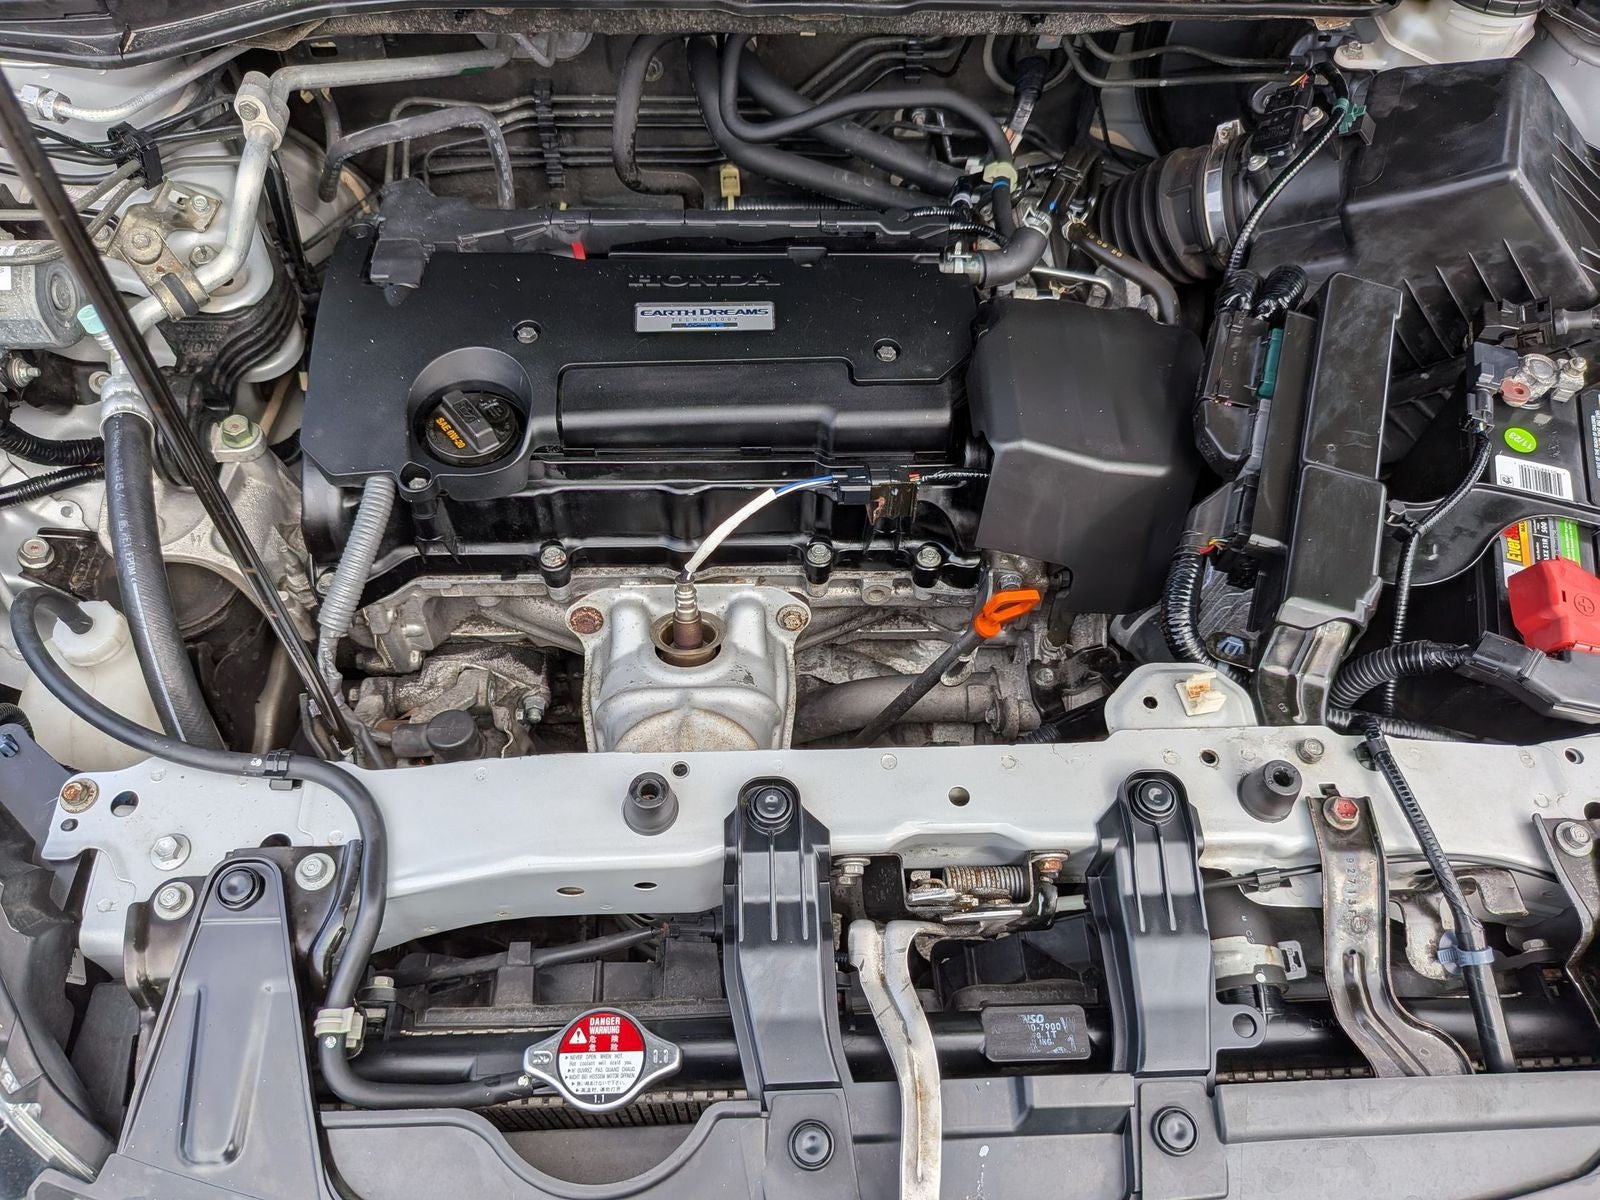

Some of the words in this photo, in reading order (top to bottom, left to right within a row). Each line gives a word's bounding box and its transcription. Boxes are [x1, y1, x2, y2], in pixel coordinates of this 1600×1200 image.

[628, 275, 781, 287] HONDA
[640, 309, 697, 317] EARTH
[700, 308, 769, 316] DREAMS
[436, 417, 452, 432] SAE
[446, 428, 466, 449] 0W-20
[1540, 521, 1548, 534] 500
[589, 1016, 621, 1026] DANGER
[589, 1025, 620, 1035] WARNUNG
[593, 1094, 605, 1104] 1.1
